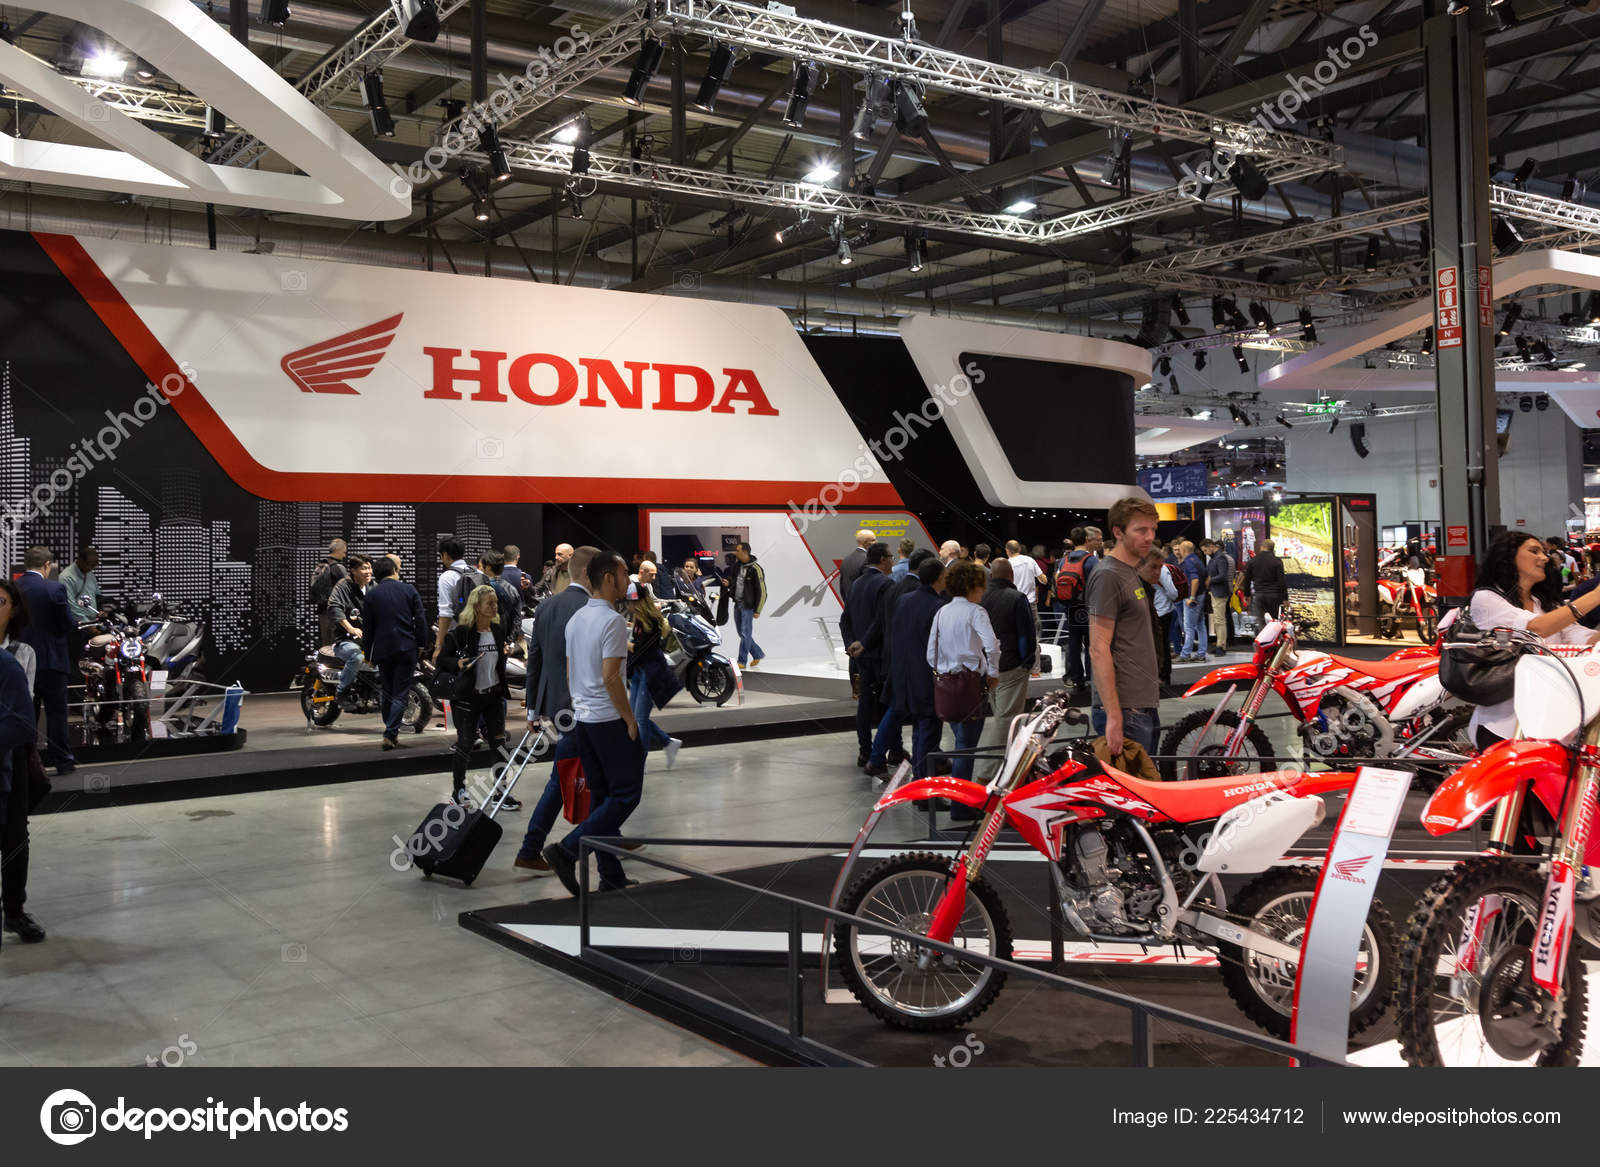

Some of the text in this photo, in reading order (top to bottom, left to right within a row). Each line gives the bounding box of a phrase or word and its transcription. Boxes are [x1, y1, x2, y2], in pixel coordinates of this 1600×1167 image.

[424, 347, 780, 417] HONDA
[1150, 472, 1174, 492] 24
[860, 519, 910, 527] DESIGN
[1224, 781, 1276, 798] HONDA
[975, 811, 1002, 860] SHOWA
[1331, 872, 1367, 885] HONDA
[1537, 886, 1562, 966] HONDA
